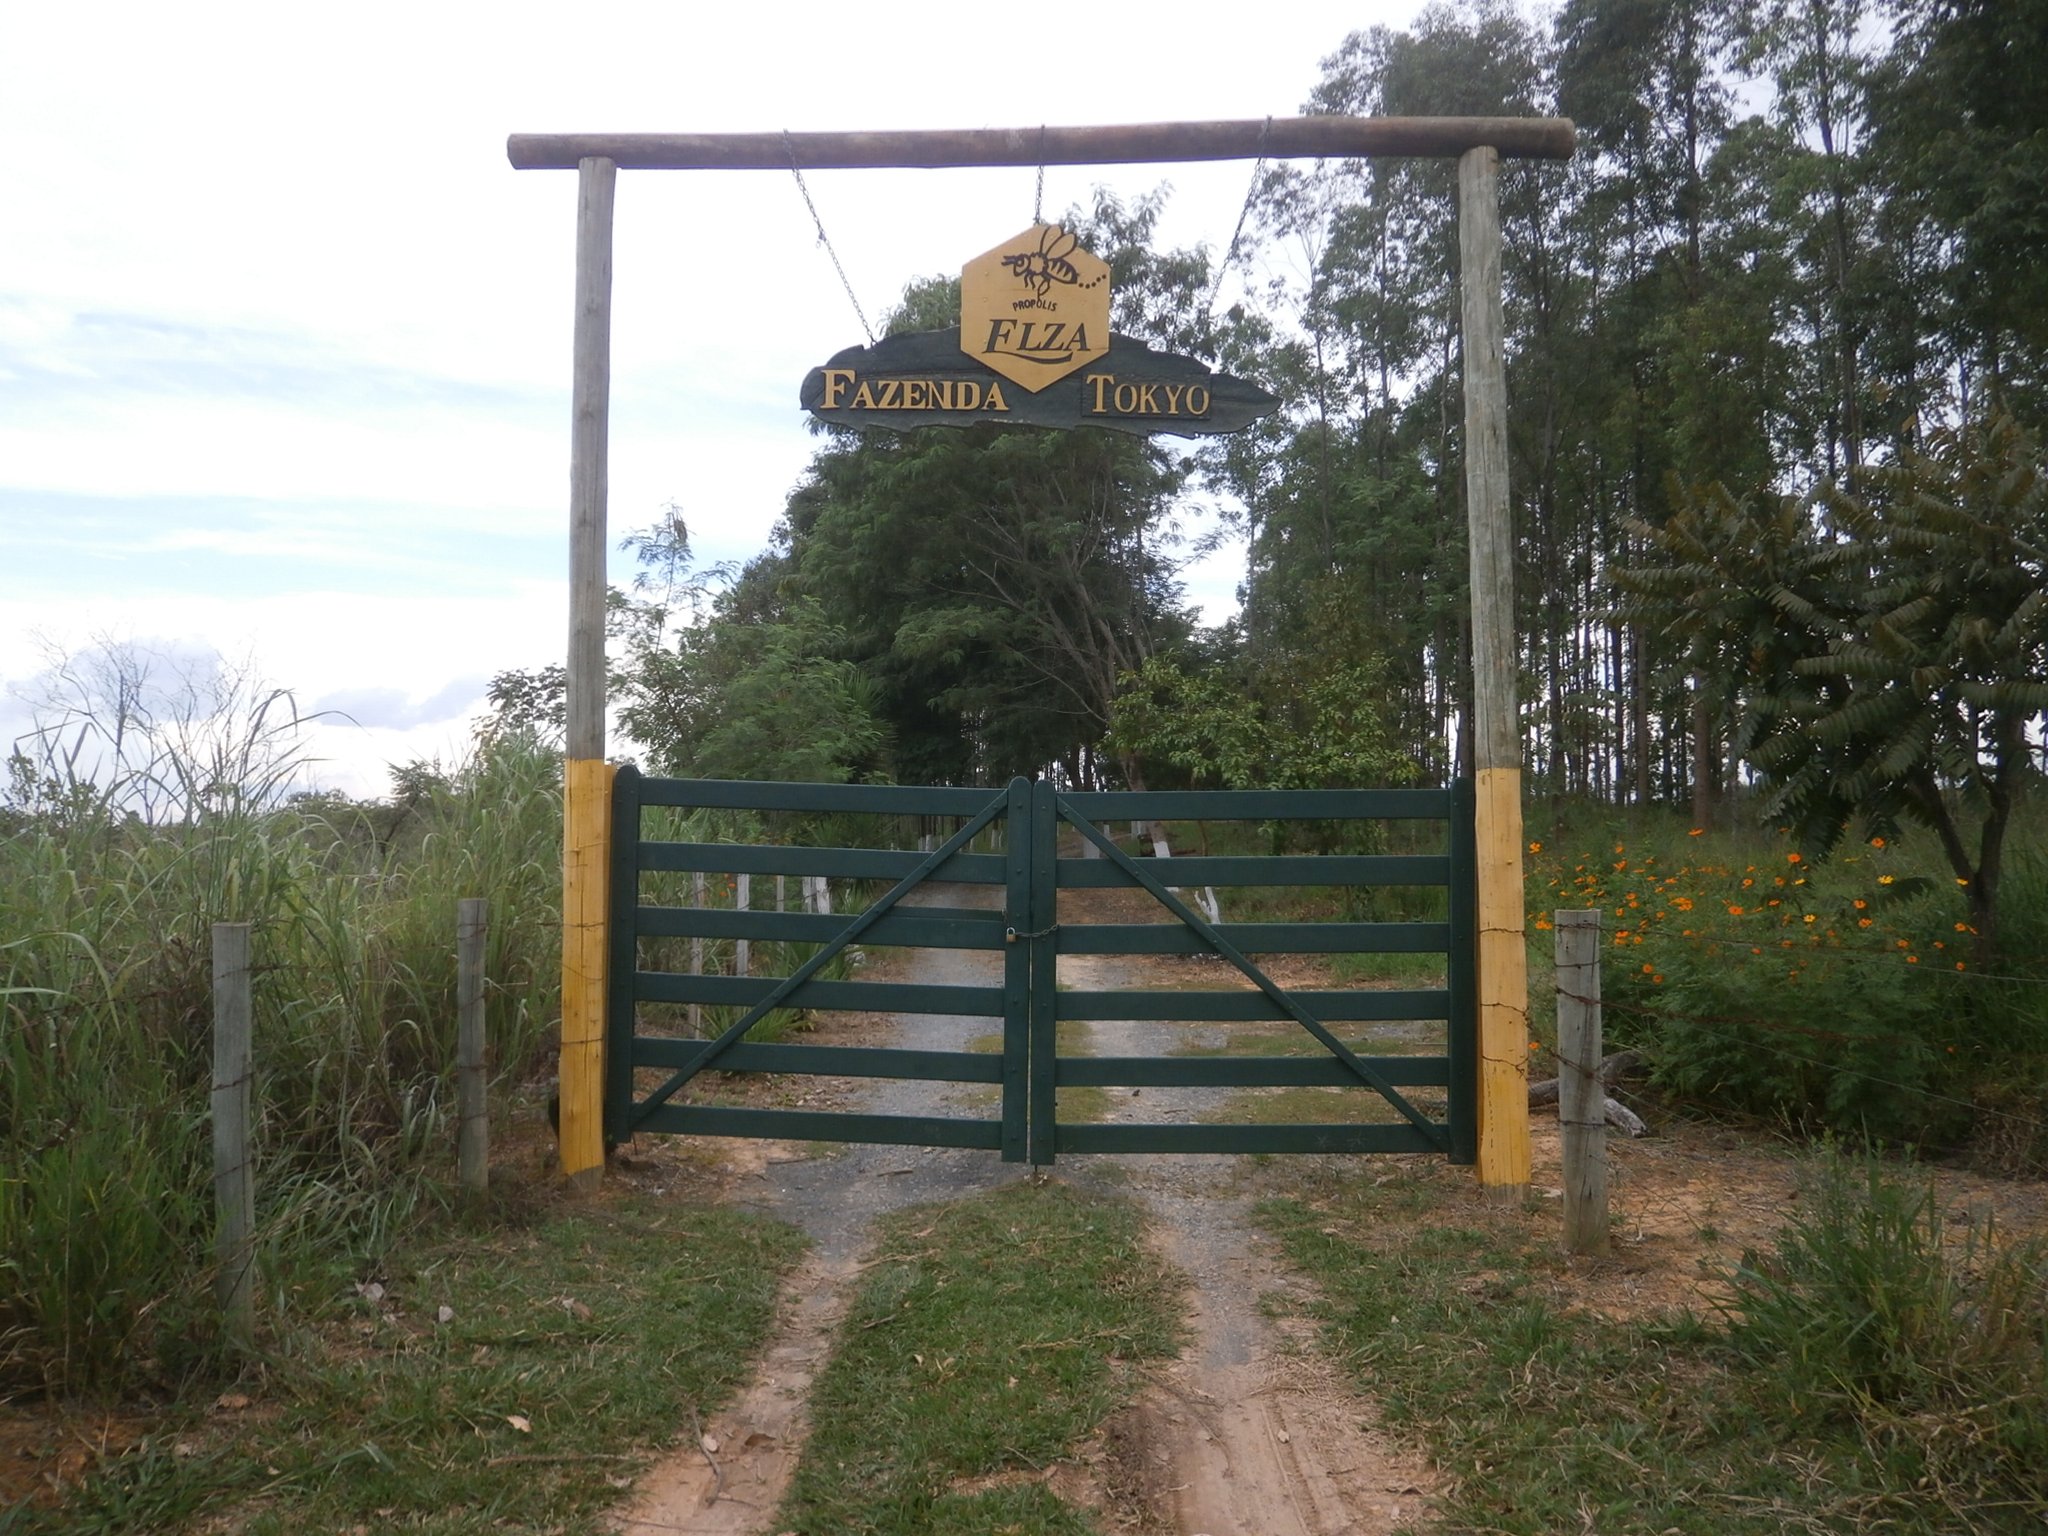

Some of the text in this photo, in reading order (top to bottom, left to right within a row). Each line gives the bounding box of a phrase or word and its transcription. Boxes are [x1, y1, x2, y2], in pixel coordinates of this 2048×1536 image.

[1012, 299, 1058, 312] PROPOLIS
[982, 319, 1091, 364] ELZA
[820, 369, 1210, 415] FAZENDA TOKYO
